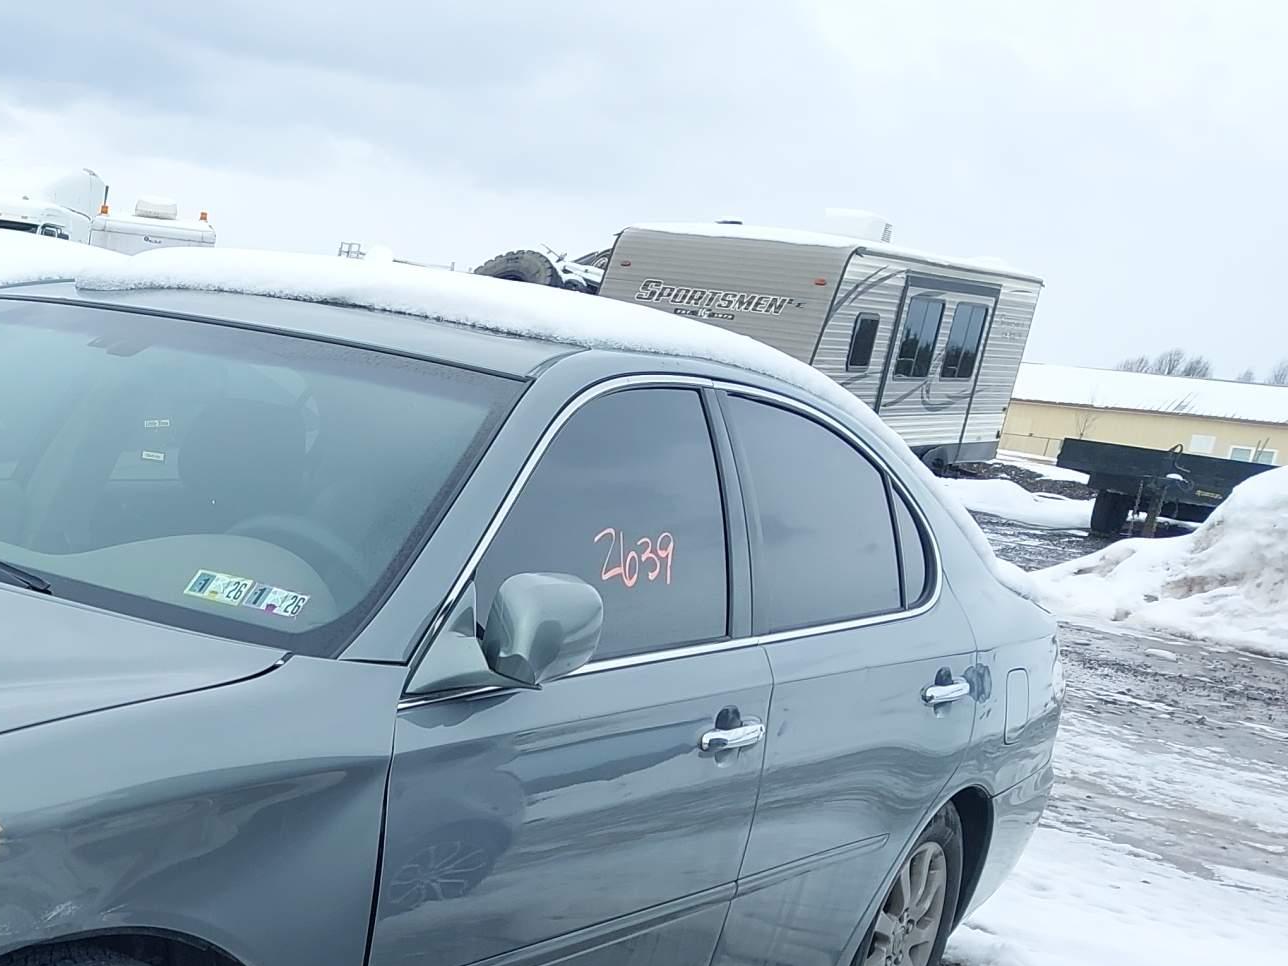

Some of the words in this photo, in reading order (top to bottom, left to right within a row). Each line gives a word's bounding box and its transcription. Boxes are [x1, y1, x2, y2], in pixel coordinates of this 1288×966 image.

[635, 278, 791, 316] SPORTSMEN
[594, 527, 674, 587] 2639
[226, 581, 248, 600] 26
[283, 595, 306, 615] 26
